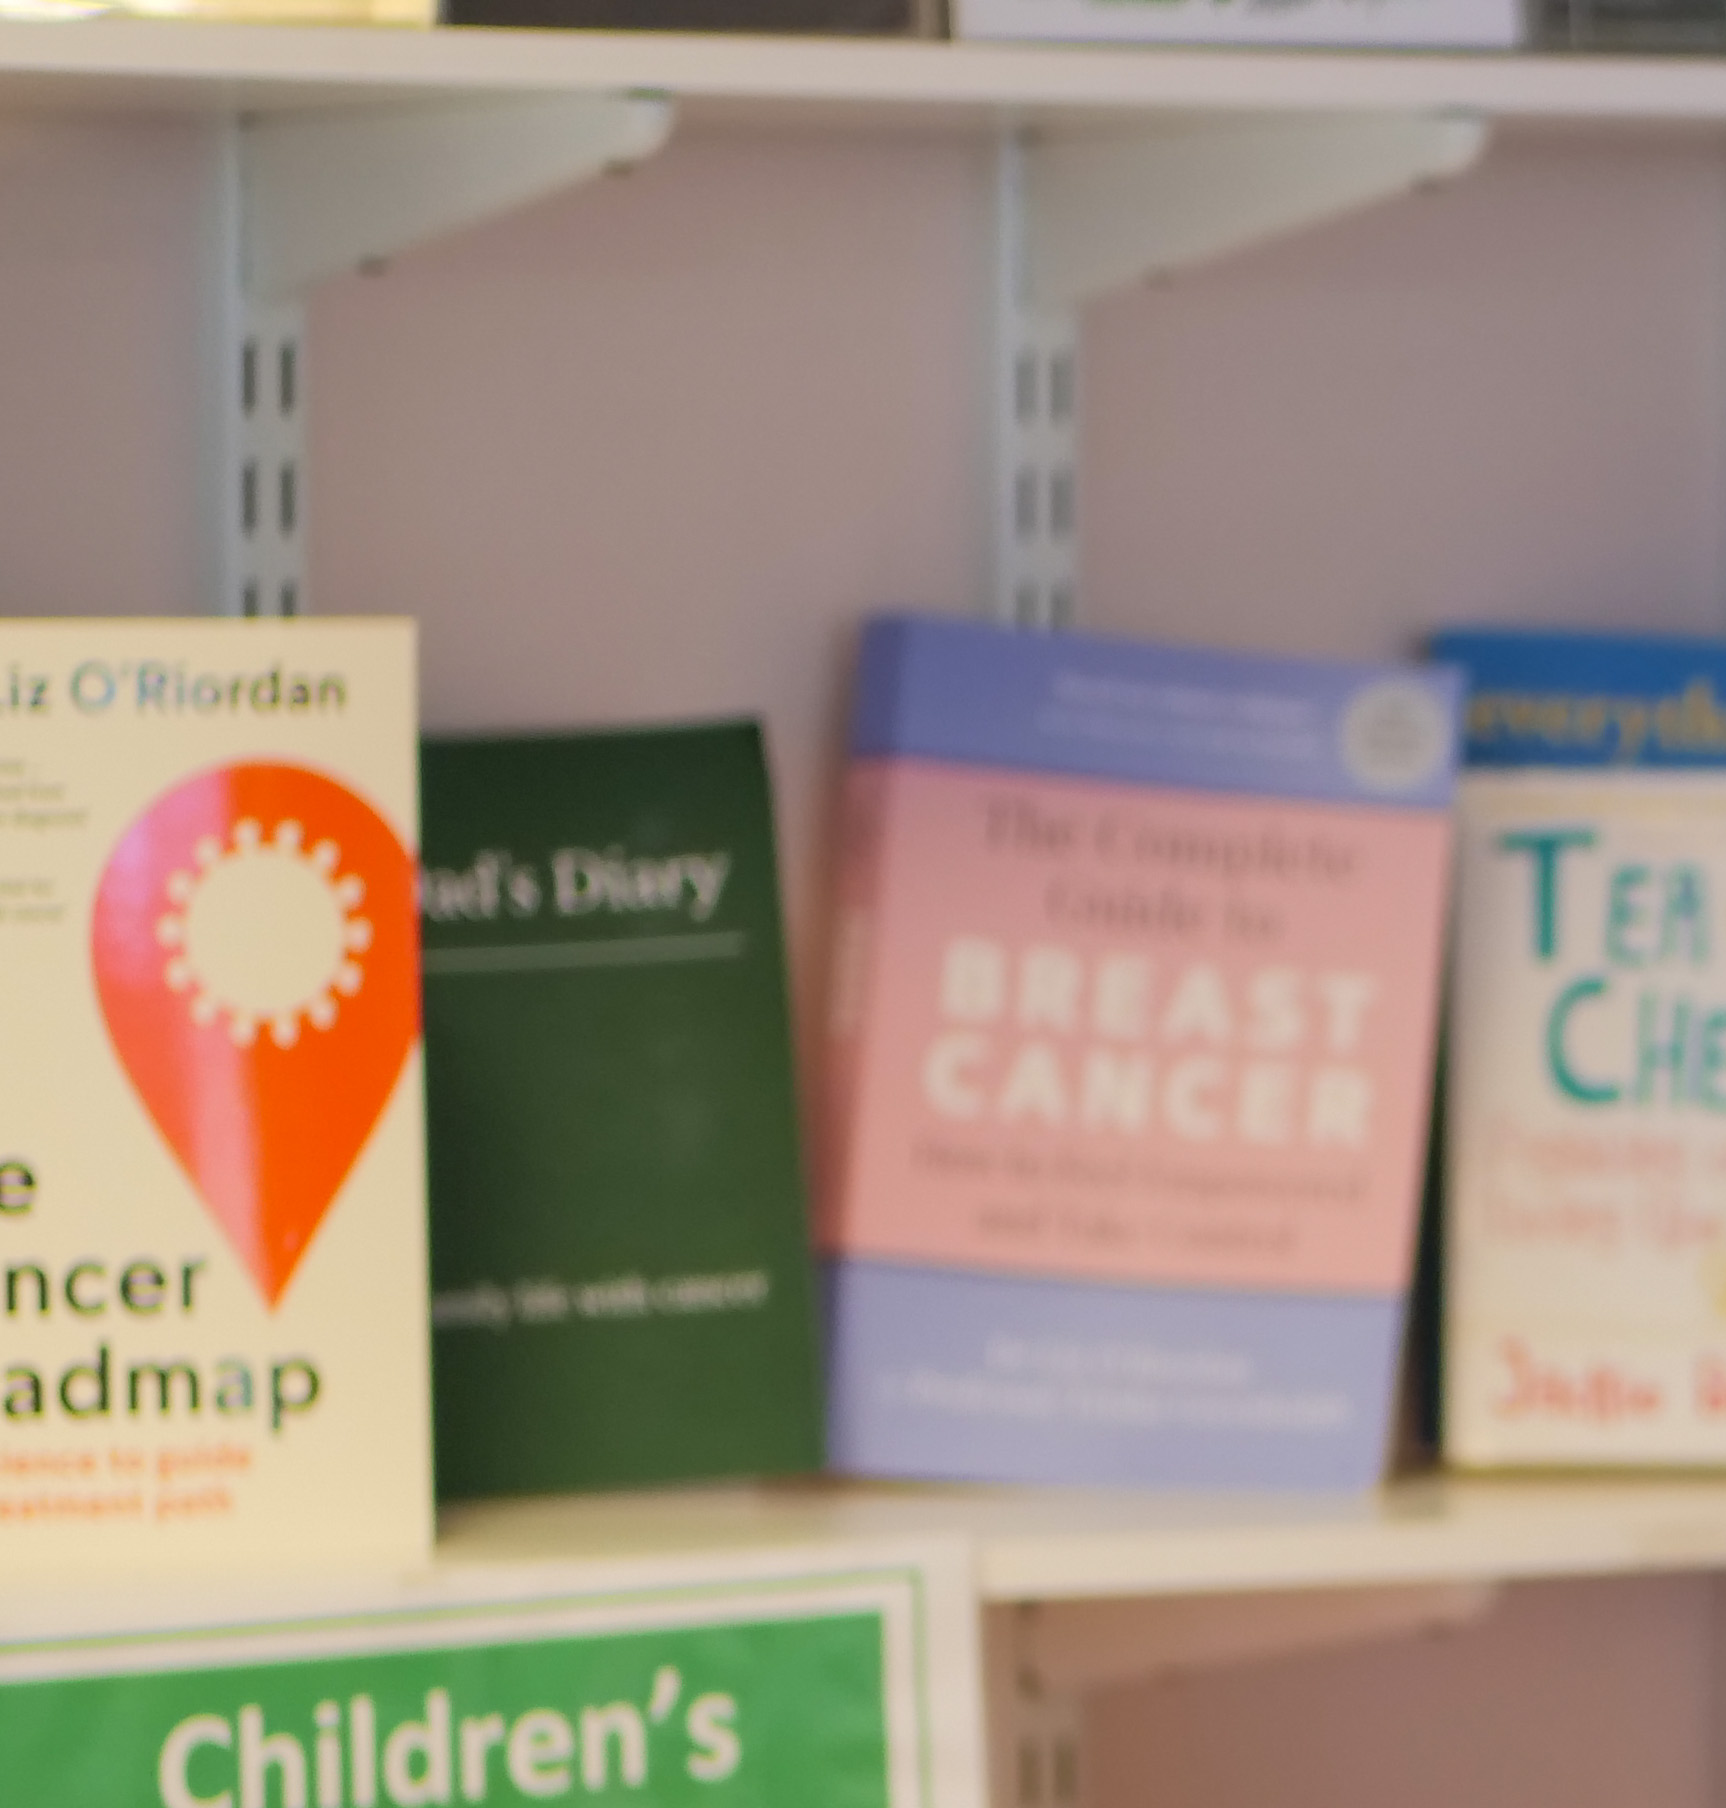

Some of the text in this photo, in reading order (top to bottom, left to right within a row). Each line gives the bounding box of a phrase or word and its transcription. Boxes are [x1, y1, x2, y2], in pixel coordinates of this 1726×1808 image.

[0, 659, 348, 713] iz O'Riordan
[552, 845, 730, 922] Diary
[1496, 826, 1710, 968] TEA
[938, 938, 1380, 1056] BREAST
[920, 1030, 1376, 1149] CANCER
[4, 1260, 207, 1315] ncer
[2, 1339, 322, 1433] admap
